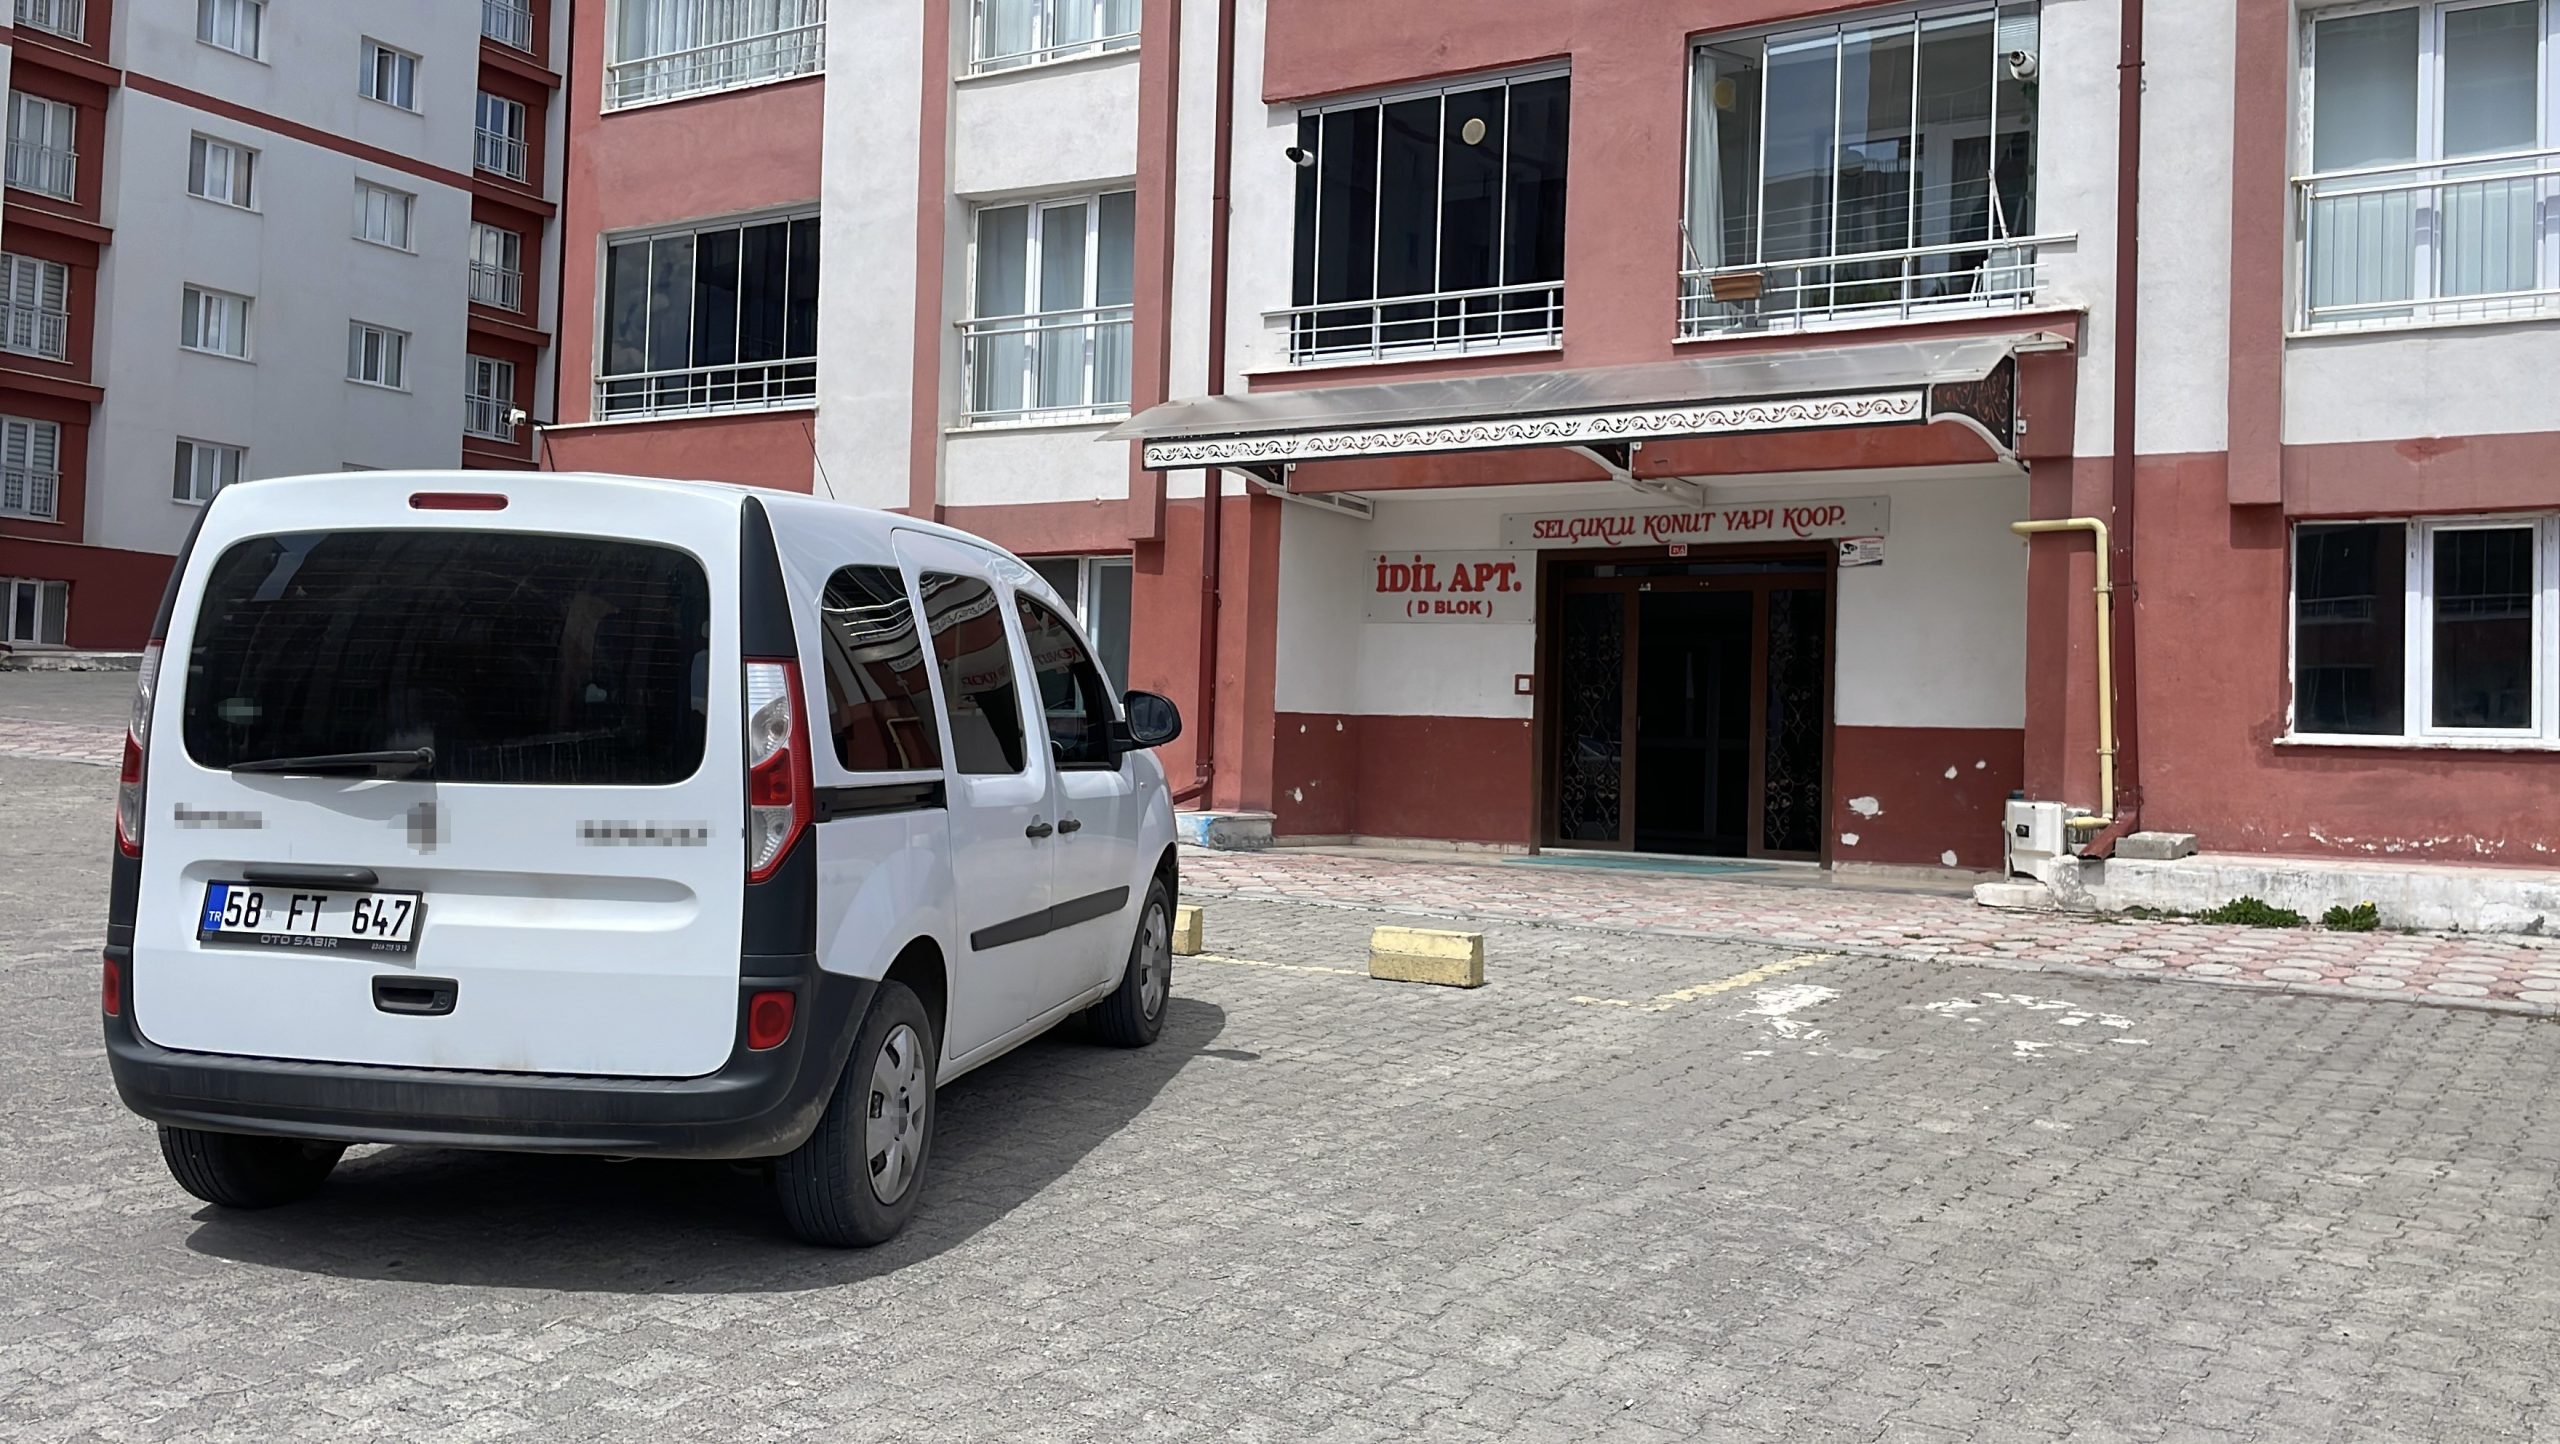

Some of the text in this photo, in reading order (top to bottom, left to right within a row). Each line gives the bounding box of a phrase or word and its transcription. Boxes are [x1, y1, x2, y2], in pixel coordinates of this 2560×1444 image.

[1533, 505, 1846, 545] SELÇUKLU KONUT YAPI KOOP.
[1376, 554, 1522, 592] İDİL APT.
[208, 911, 222, 923] TR
[224, 891, 412, 937] 58 FT 647
[260, 934, 338, 948] OTO SABIR
